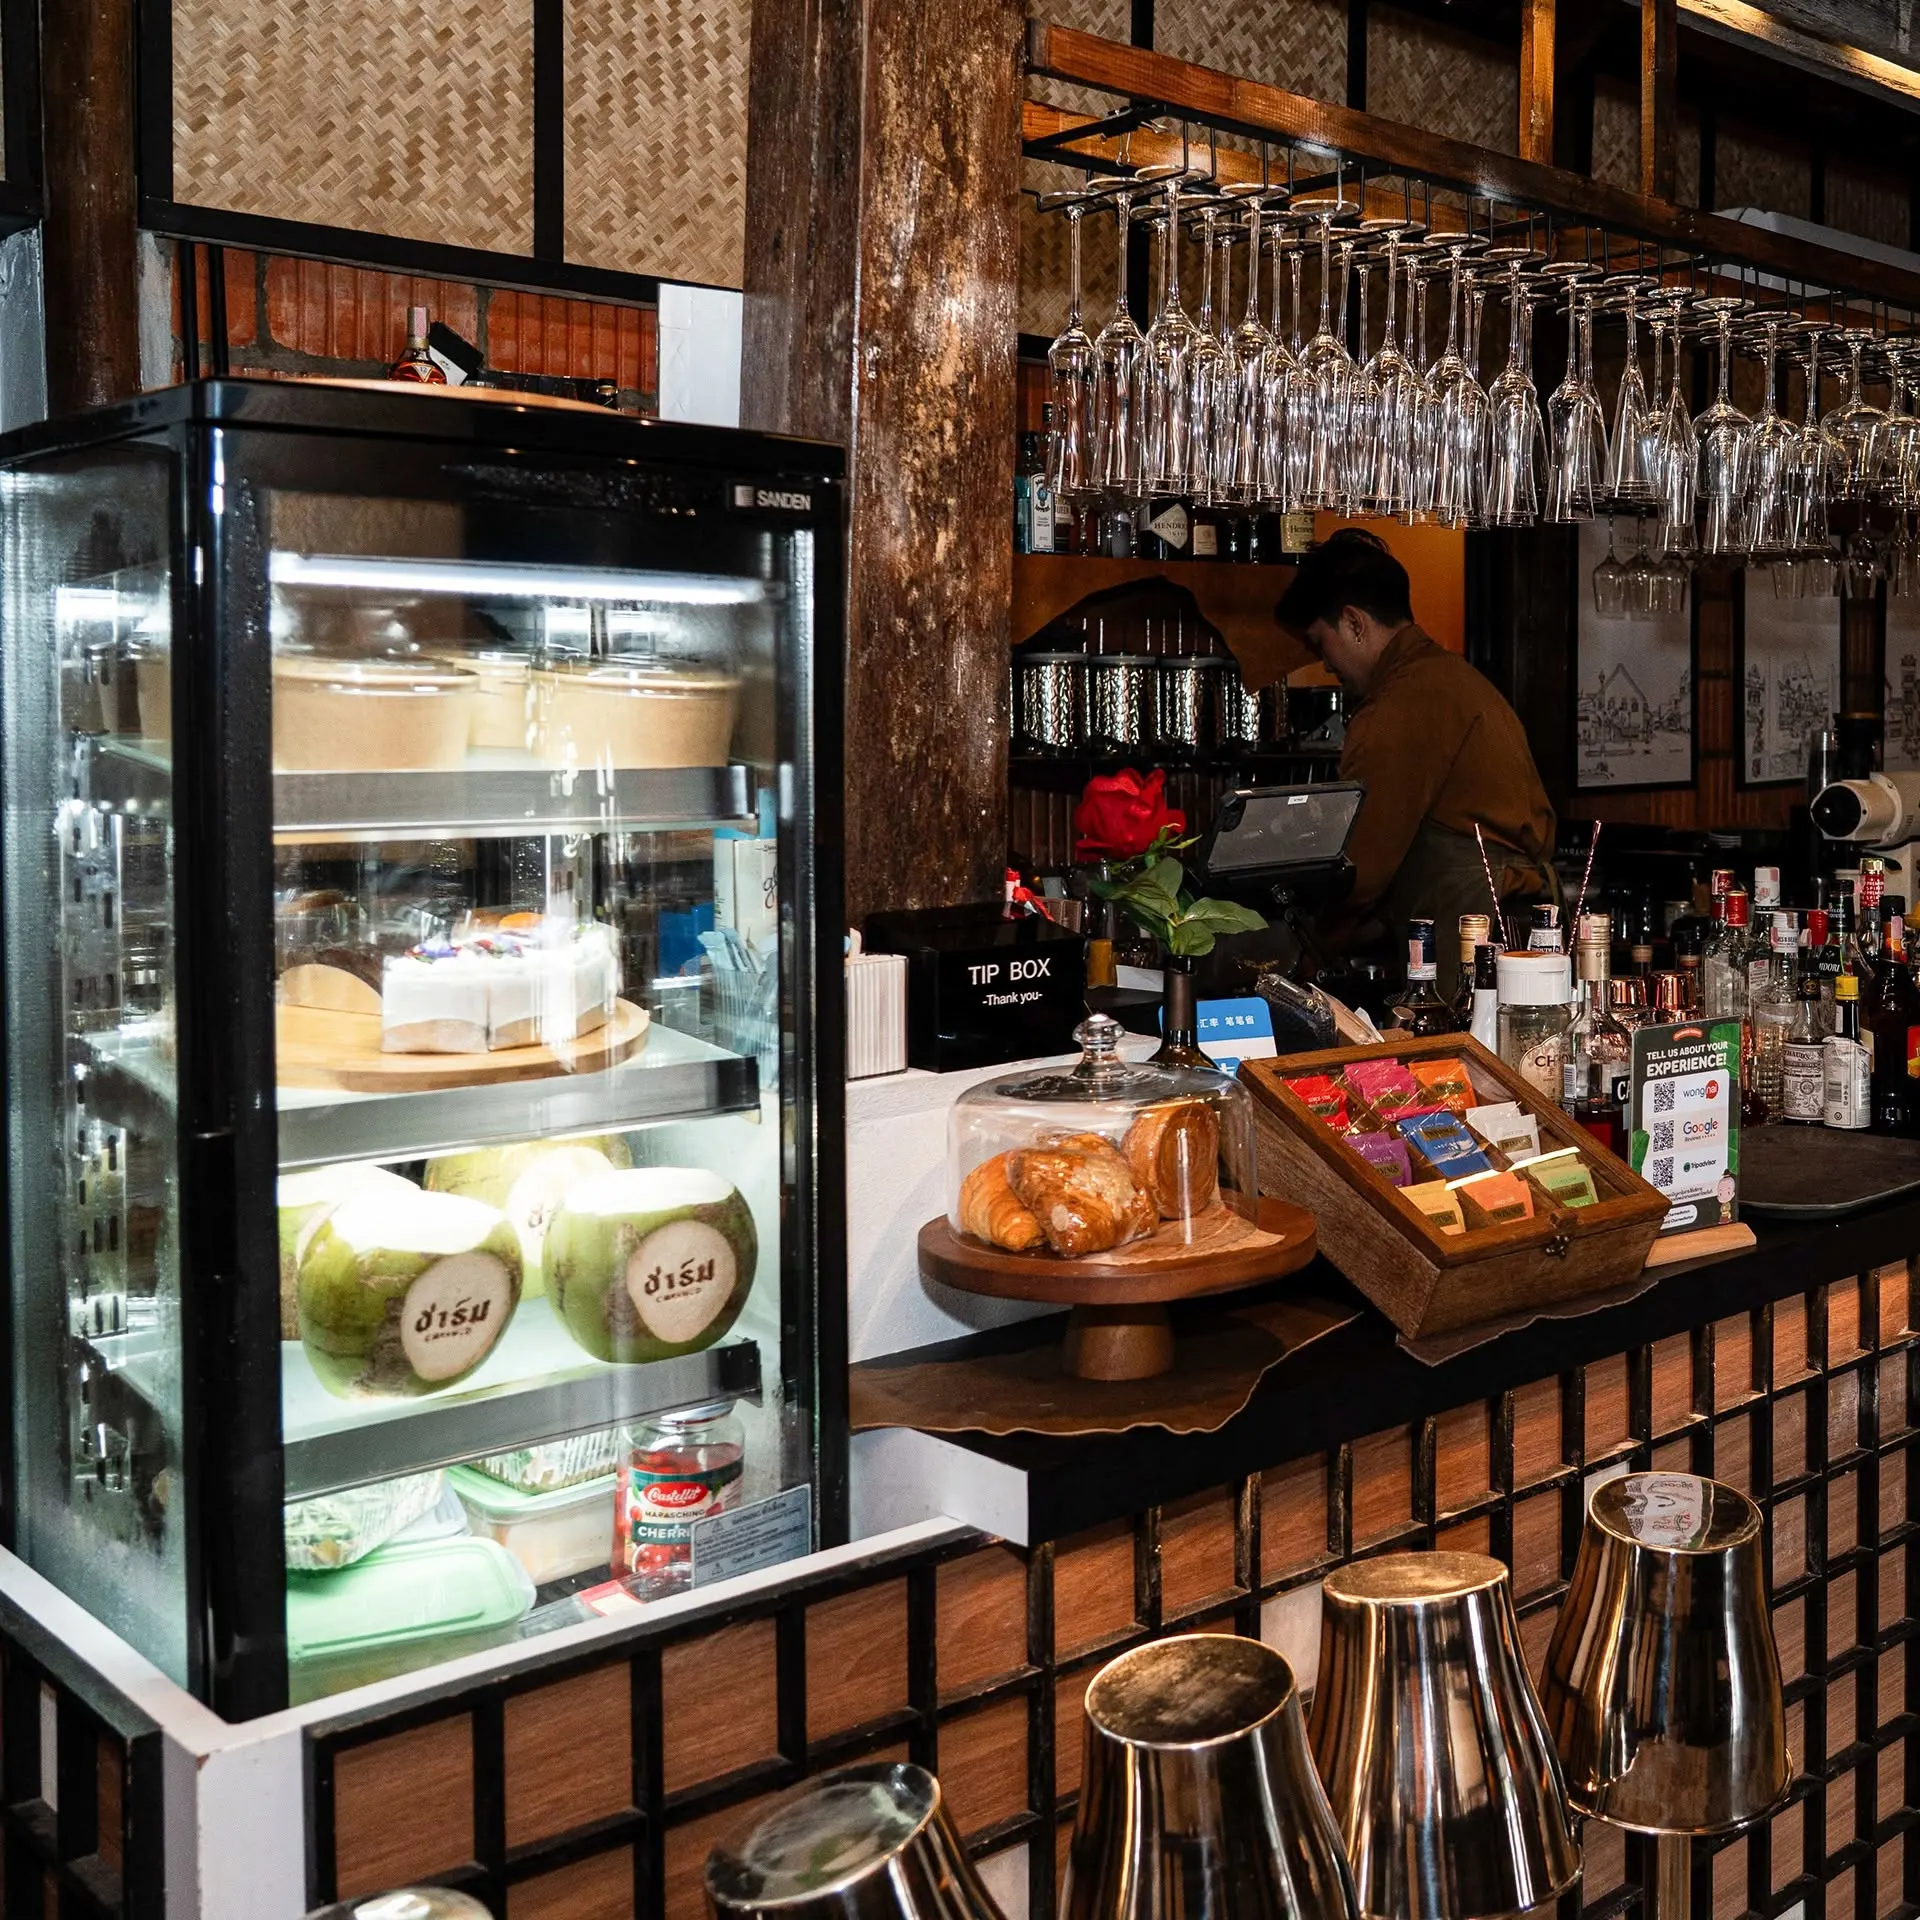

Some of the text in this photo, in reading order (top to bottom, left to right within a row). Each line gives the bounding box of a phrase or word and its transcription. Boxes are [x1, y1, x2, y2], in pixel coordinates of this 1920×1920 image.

[756, 489, 811, 511] SANDEN
[967, 957, 1051, 985] TIP BOX
[982, 991, 1043, 1006] -Thank you-
[1197, 1017, 1219, 1028] 汇率
[1646, 1041, 1729, 1061] TELL US ABOUT YOUR
[1646, 1053, 1727, 1077] EXPERIENCE!
[1683, 1083, 1718, 1099] wongnai
[1683, 1118, 1719, 1135] Google
[1691, 1159, 1717, 1169] Tripadvisor
[645, 1508, 706, 1520] MARASCHINO
[637, 1524, 691, 1540] CHERRI
